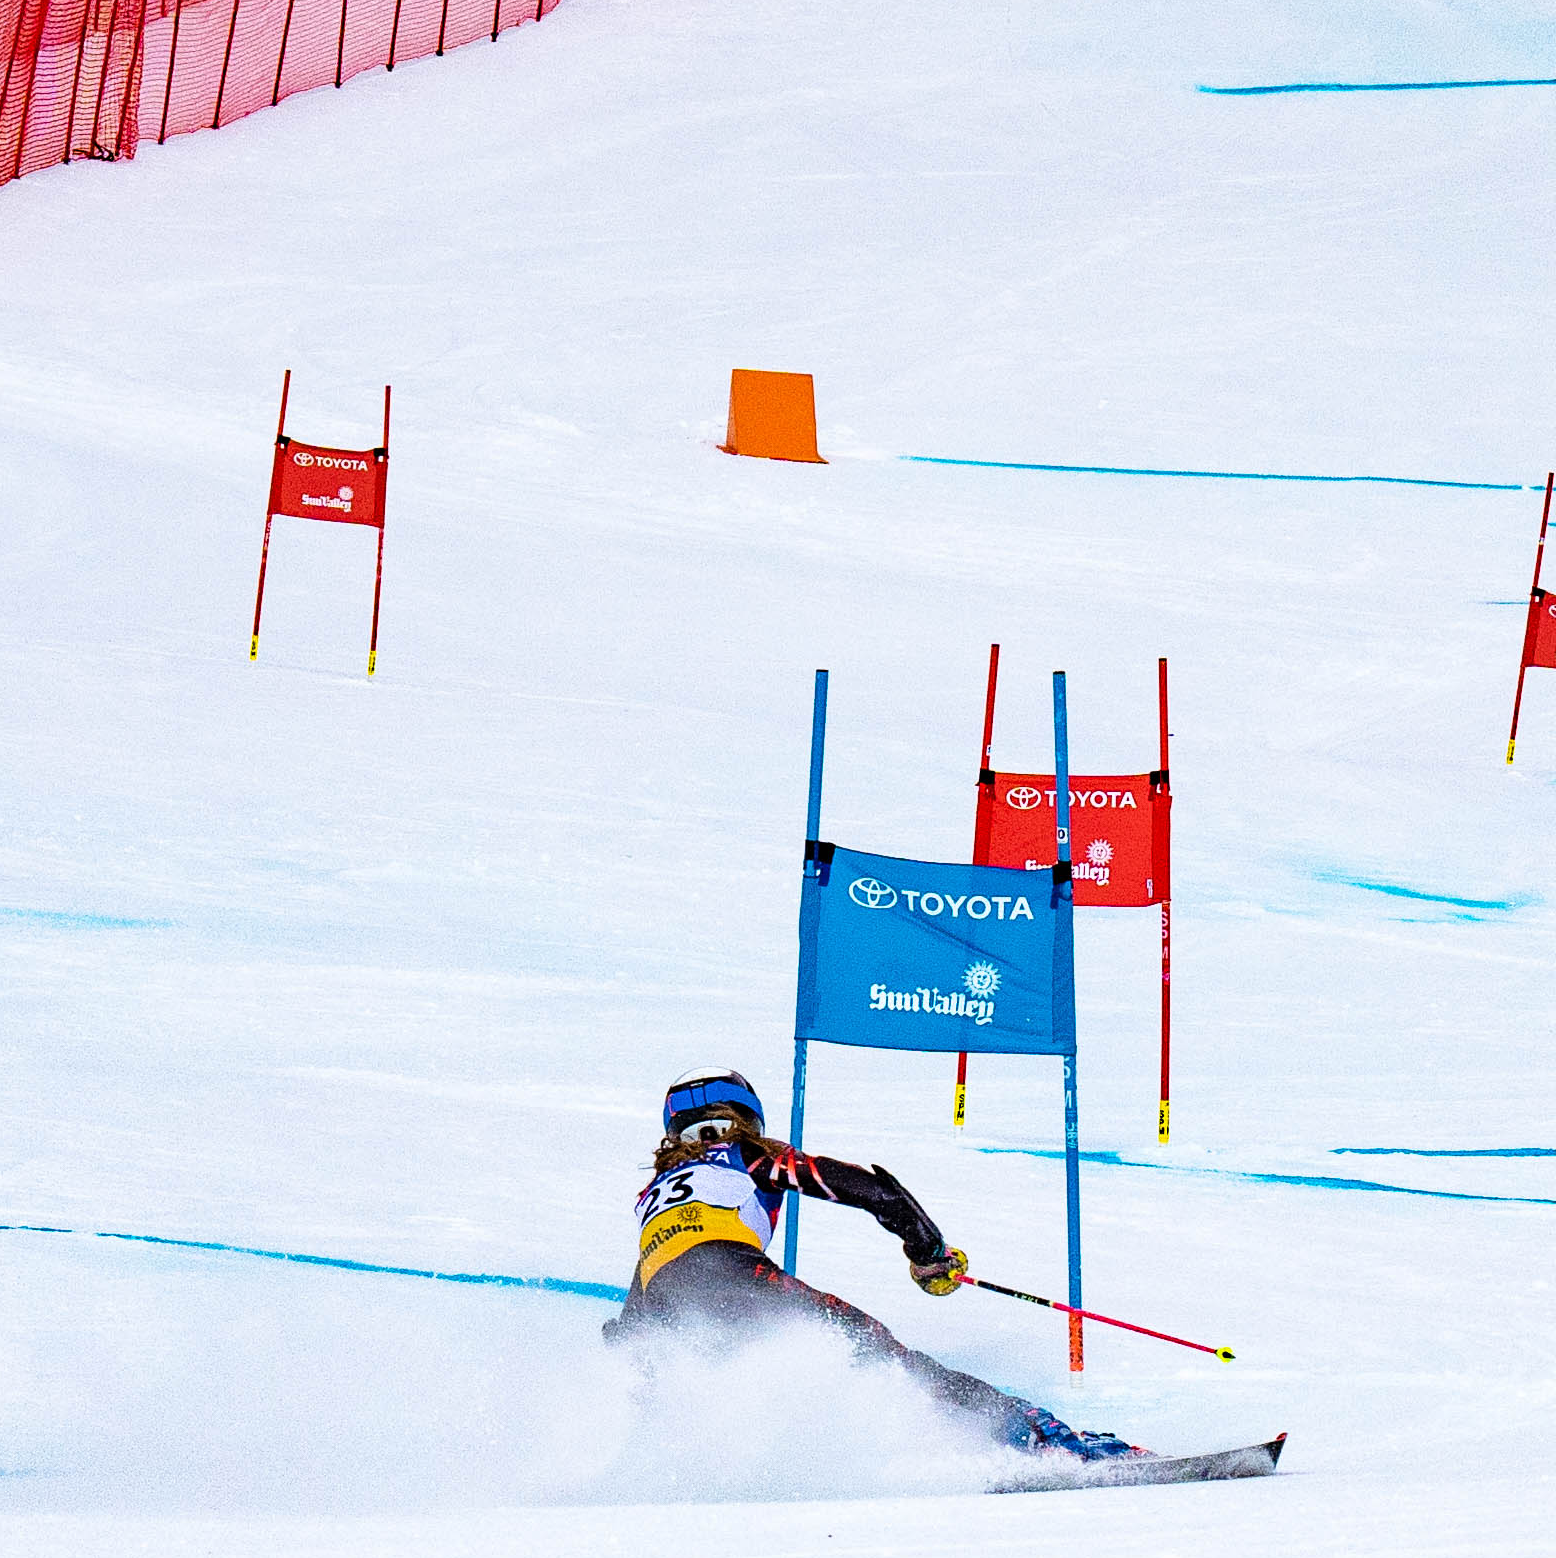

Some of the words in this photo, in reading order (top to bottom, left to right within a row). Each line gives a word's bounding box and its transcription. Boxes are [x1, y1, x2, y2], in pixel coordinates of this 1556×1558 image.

[315, 455, 369, 472] TOYOTA
[900, 888, 1034, 921] TOYOTA
[640, 1170, 695, 1228] 23
